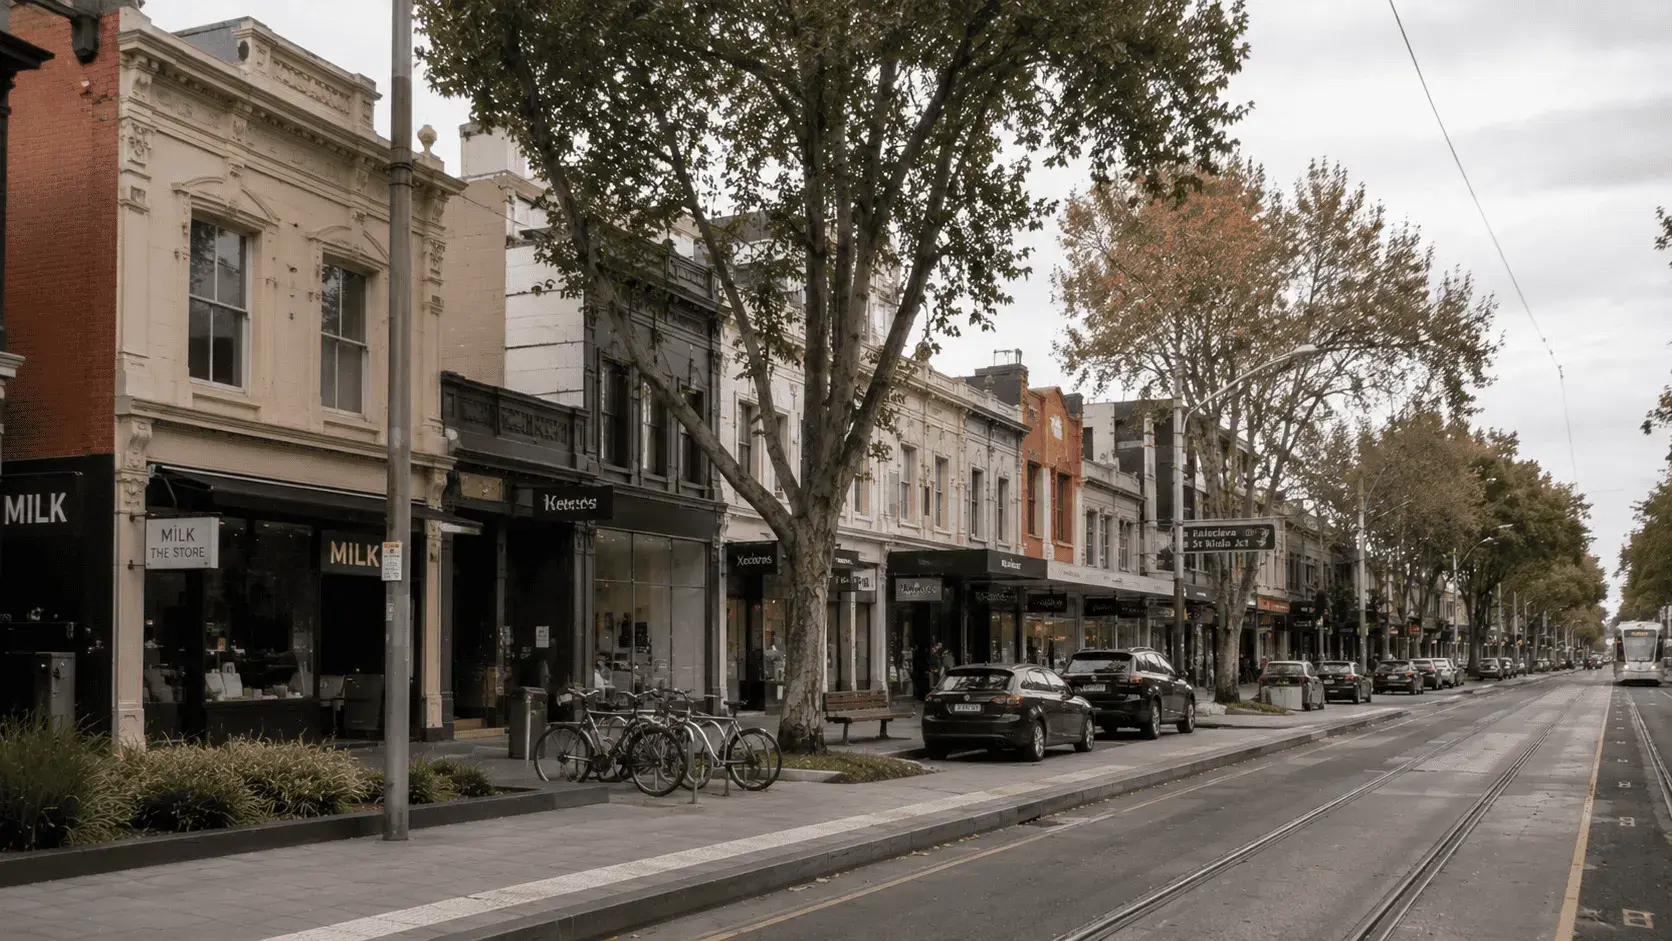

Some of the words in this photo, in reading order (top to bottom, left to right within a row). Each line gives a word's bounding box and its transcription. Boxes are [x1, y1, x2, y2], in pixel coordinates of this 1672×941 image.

[4, 492, 68, 525] MILK
[151, 547, 170, 558] THE
[173, 546, 205, 558] STORE
[330, 540, 380, 568] MILK
